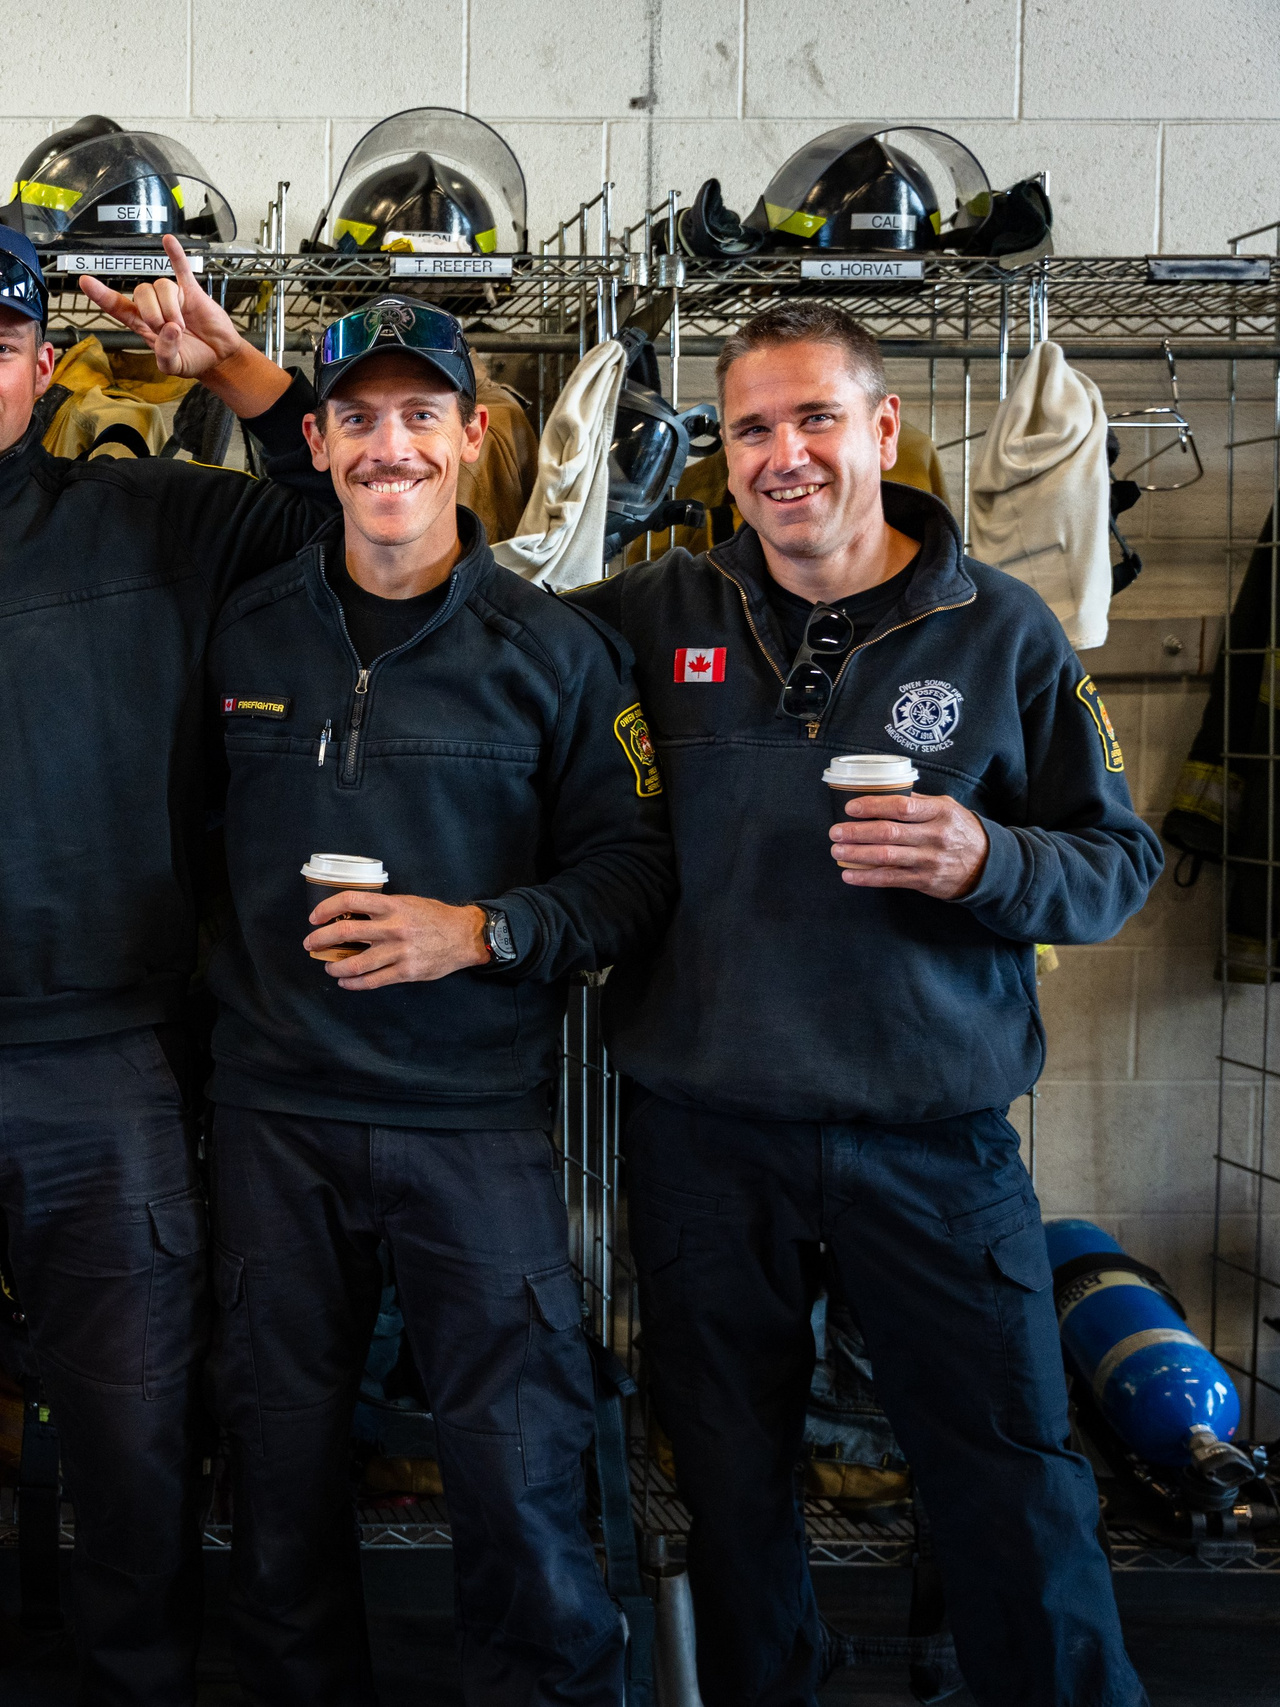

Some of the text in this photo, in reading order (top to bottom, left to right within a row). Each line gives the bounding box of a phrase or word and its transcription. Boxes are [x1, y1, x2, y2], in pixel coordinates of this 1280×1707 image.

[871, 215, 900, 228] CAL
[75, 257, 174, 270] S. HEFFERNA
[415, 260, 492, 272] T. REEFER
[821, 263, 903, 276] C. HORVAT
[898, 679, 965, 703] OWEN SOUND FIRE
[916, 689, 945, 700] OSFES
[237, 700, 285, 713] FIREFIGHTER
[883, 723, 954, 753] EMERGENCY SERVICES
[906, 726, 921, 738] EST
